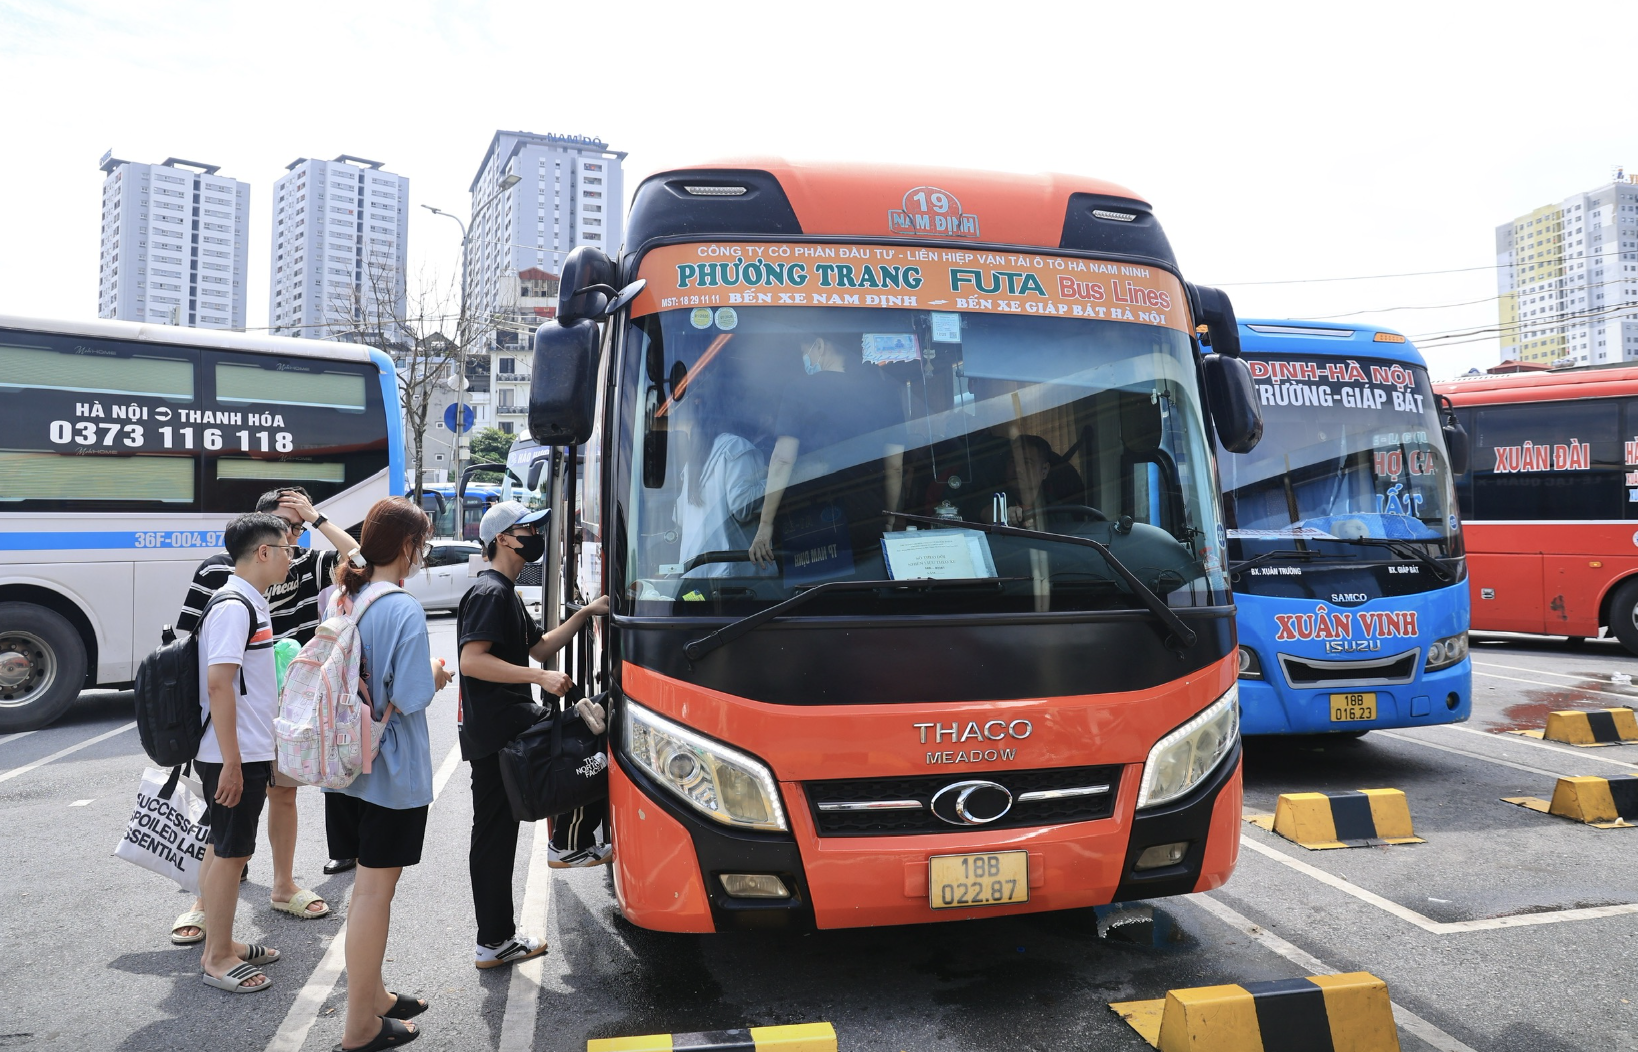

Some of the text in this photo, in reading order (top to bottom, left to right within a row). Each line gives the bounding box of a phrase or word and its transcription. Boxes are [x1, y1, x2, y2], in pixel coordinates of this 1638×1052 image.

[913, 191, 949, 213] 19
[893, 213, 975, 234] NAM ĐỊNH
[676, 256, 924, 290] PHƯƠNG TRANG
[697, 244, 742, 257] CÔNG
[746, 246, 765, 257] TY
[874, 249, 895, 260] TƯ
[907, 248, 938, 261] LIÊN
[942, 252, 974, 265] HIỆP
[977, 254, 1005, 267] VẬN
[1008, 255, 1030, 267] TẢI
[1033, 256, 1044, 268] Ô
[1047, 258, 1065, 270] TÔ
[1068, 260, 1087, 272] HÀ
[1090, 263, 1118, 275] NAM
[1121, 266, 1150, 278] NINH
[661, 294, 720, 308] MST: 18 29 11 11
[728, 288, 918, 308] BẾN XE NAM ĐỊNH
[949, 266, 1172, 311] FUTA Bus Lines
[955, 294, 1166, 326] BẾN XE GIÁP BÁT HÀ NỘI
[1370, 364, 1416, 391] NỘI
[1255, 380, 1424, 414] RƯỜNG-GIÁP BÁT
[75, 401, 285, 428] HÀ NỘI THANH HÓA
[49, 420, 294, 453] 0373 116 118
[1374, 449, 1403, 481] HỢ
[1493, 440, 1550, 474] XUÂN
[1553, 438, 1591, 471] ĐÀI
[134, 531, 225, 548] 36F-004.97
[1331, 593, 1368, 602] SAMCO
[1274, 604, 1419, 641] XUÂN VINH
[1325, 640, 1381, 654] ISUZU
[1344, 694, 1364, 707] 18B
[1335, 708, 1372, 721] 016.23
[913, 719, 1033, 744] THACO
[926, 748, 1017, 765] MEADOW
[961, 856, 1000, 879] 18B
[941, 879, 1017, 906] 022.87
